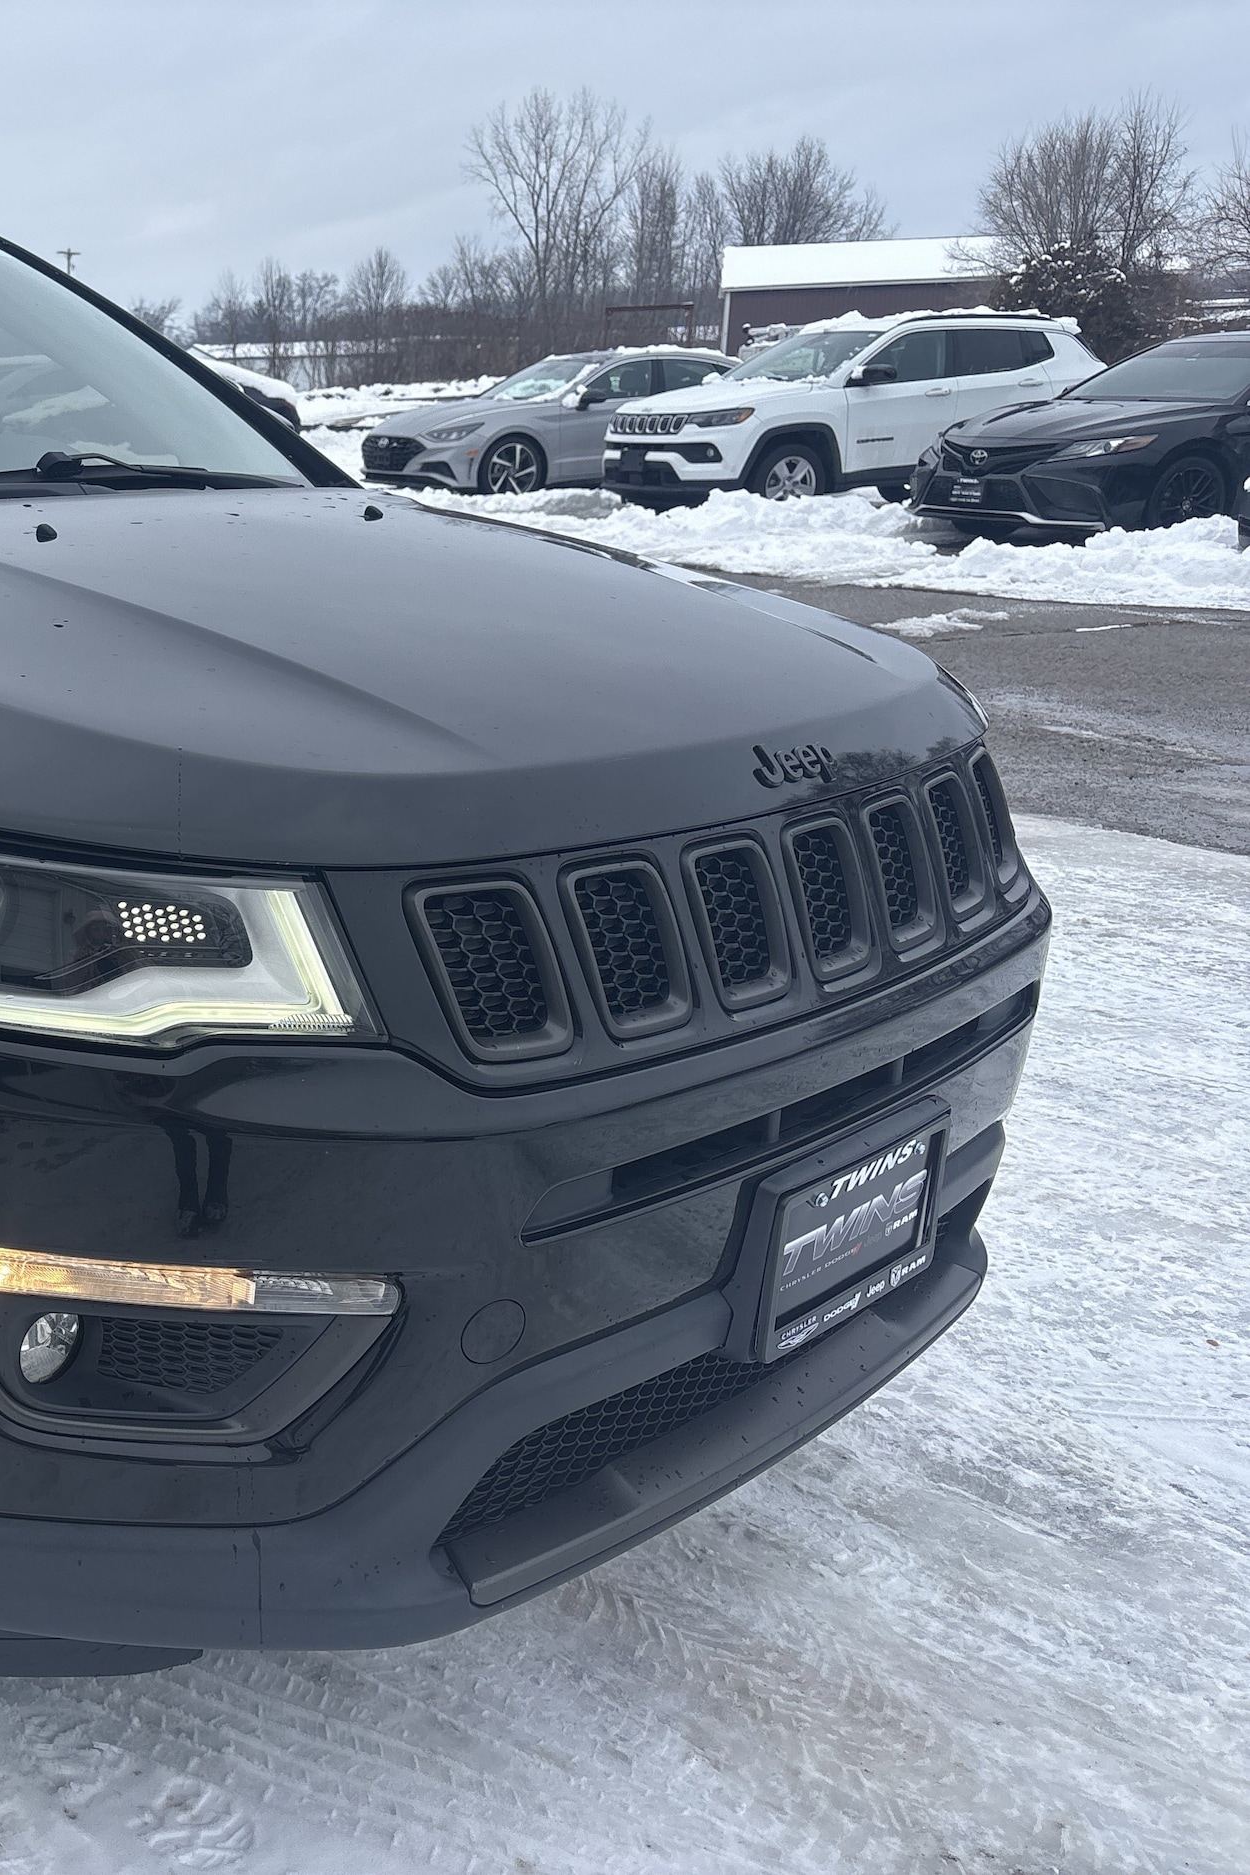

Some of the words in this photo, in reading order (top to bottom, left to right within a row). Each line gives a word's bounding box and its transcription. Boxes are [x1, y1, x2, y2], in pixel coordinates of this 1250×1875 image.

[752, 742, 837, 788] Jeep
[830, 1139, 917, 1200] TWINS
[779, 1266, 822, 1292] CHRYSLER
[892, 1208, 918, 1230] RAM
[783, 1168, 928, 1277] TWINS
[781, 1315, 818, 1341] CHRYSLER
[866, 1280, 886, 1298] Jeep
[901, 1254, 926, 1277] RAM
